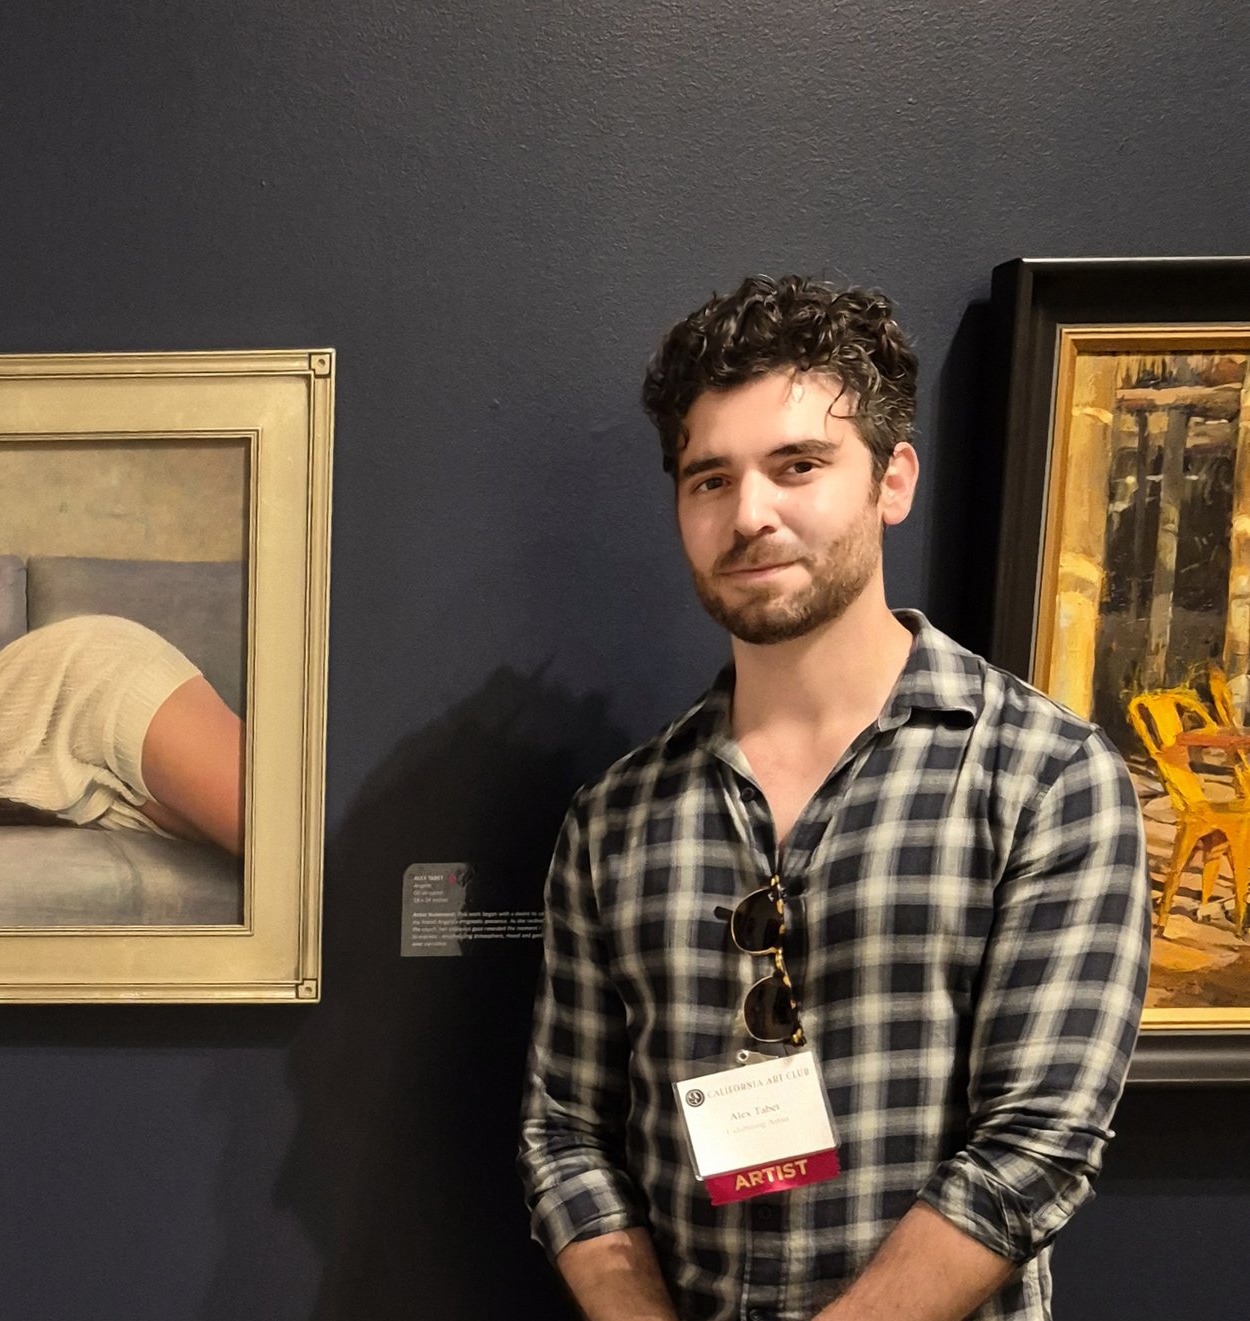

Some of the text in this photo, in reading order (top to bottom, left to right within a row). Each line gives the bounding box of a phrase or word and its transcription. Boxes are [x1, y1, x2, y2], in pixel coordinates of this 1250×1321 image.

[707, 1067, 810, 1099] CALIFORNIA ART CLUB
[730, 1111, 752, 1121] Alex
[735, 1159, 808, 1191] ARTIST
